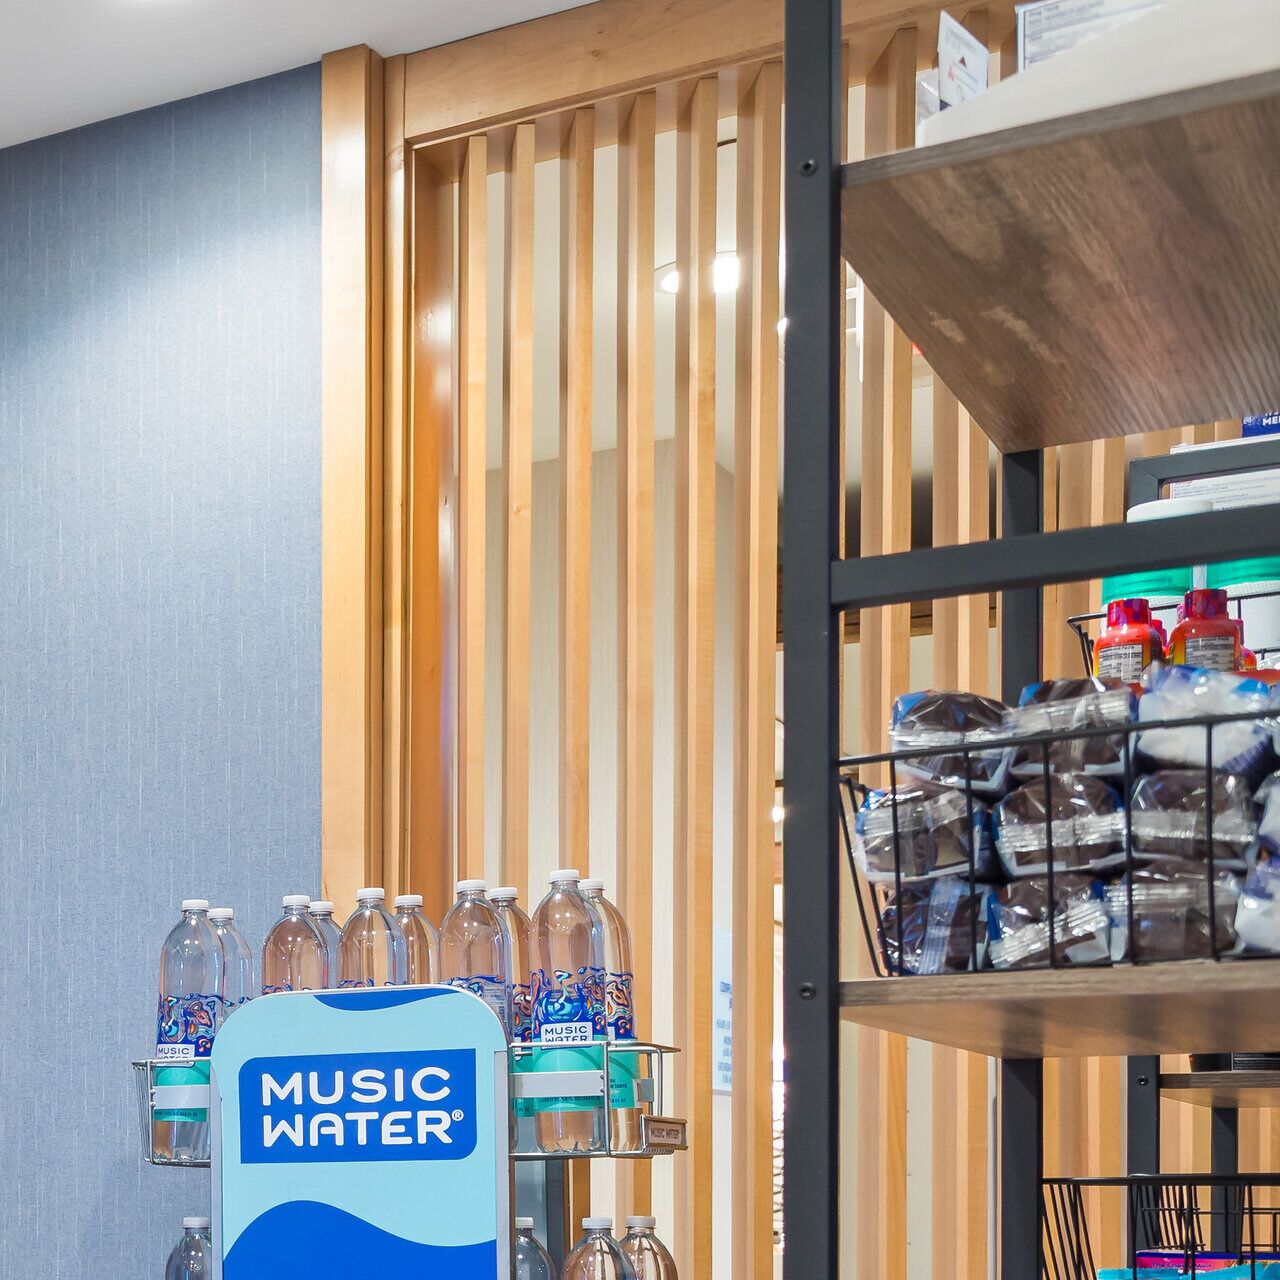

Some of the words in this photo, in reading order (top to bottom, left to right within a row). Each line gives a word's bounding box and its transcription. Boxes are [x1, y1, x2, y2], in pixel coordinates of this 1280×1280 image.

[544, 1025, 588, 1036] MUSIC
[158, 1047, 190, 1055] MUSIC
[261, 1066, 451, 1107] MUSIC
